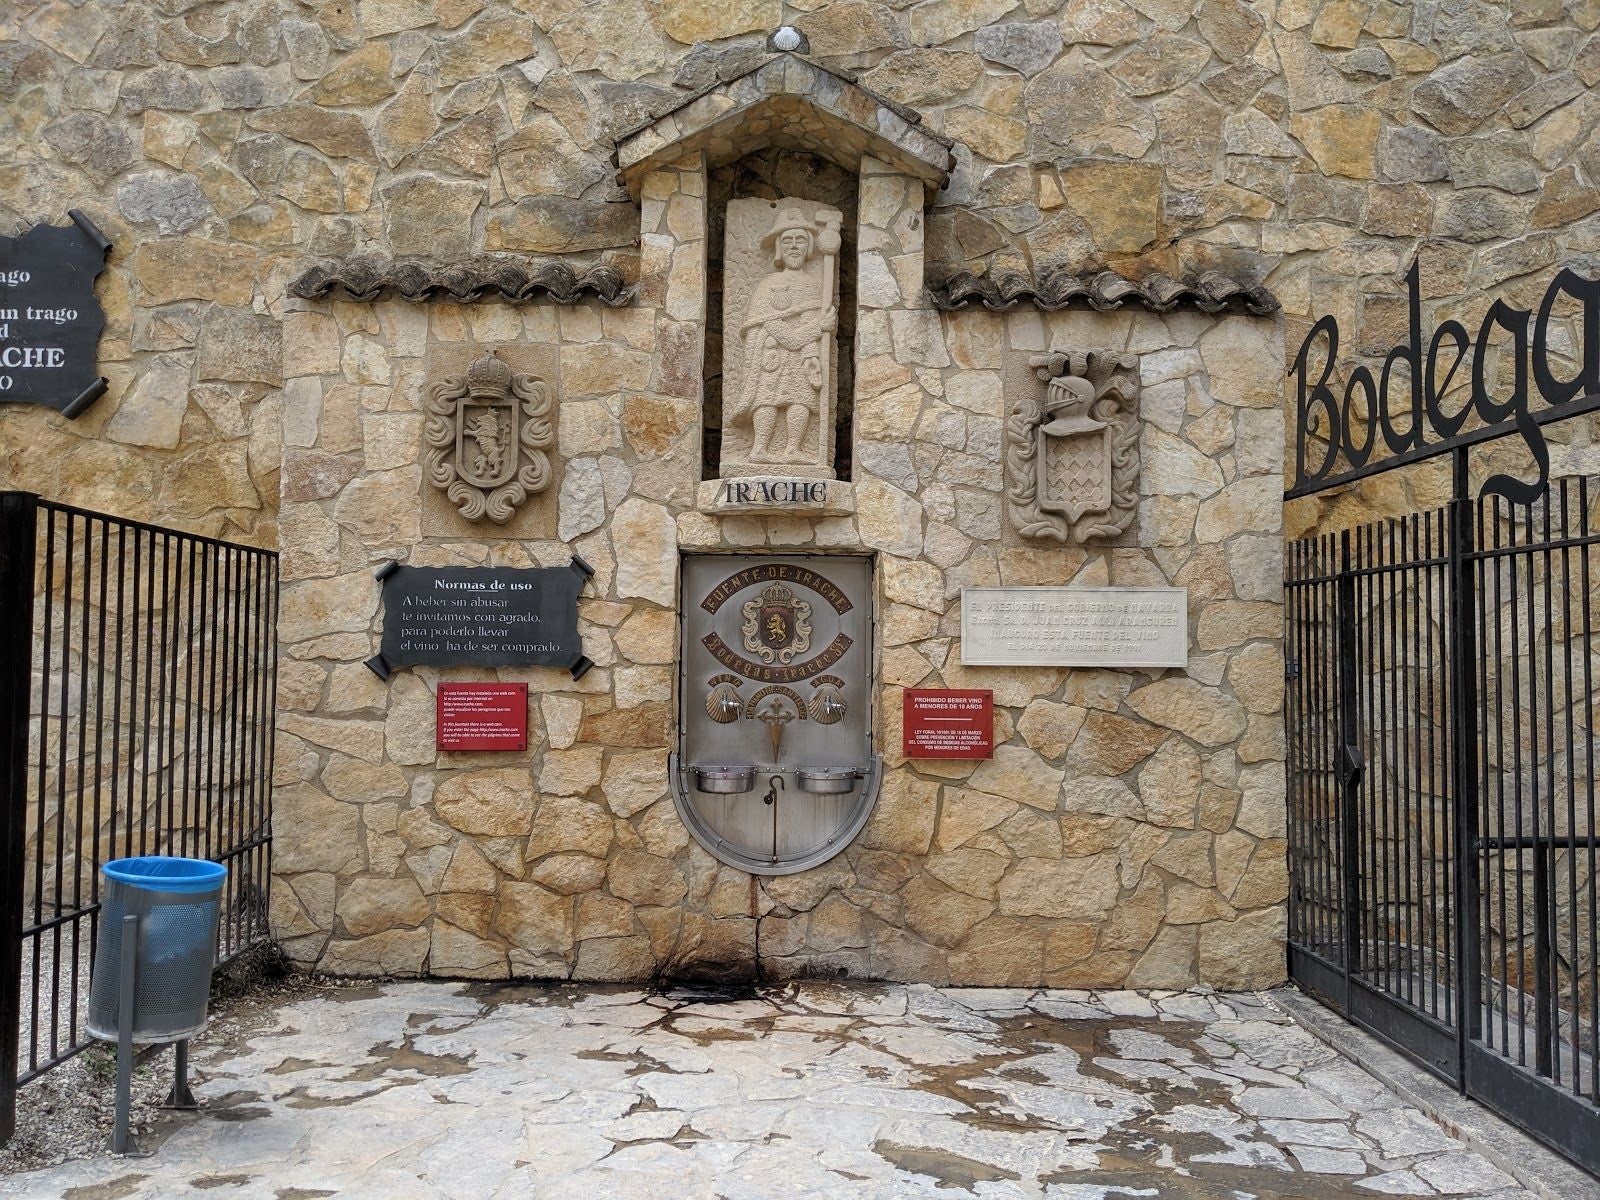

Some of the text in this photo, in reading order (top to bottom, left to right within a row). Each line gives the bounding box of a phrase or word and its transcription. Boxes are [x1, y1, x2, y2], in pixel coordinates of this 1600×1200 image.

[26, 306, 78, 325] trago
[0, 346, 65, 368] CHE
[725, 481, 827, 503] IRACHE
[434, 580, 532, 590] Normas de uso
[706, 567, 847, 608] FUENTE DE IRACHE
[402, 596, 509, 607] A beber sin abusar
[402, 612, 412, 621] te
[416, 612, 471, 621] invitamos
[1033, 616, 1059, 626] JUAN
[1063, 616, 1088, 626] CRUZ
[401, 626, 509, 637] para poderlo llevar
[1042, 630, 1068, 640] ESTA
[1073, 630, 1110, 640] FUENTE
[1113, 630, 1131, 640] DEL
[401, 641, 410, 650] el
[414, 642, 439, 650] vino
[447, 641, 460, 650] ha
[464, 641, 478, 650] de
